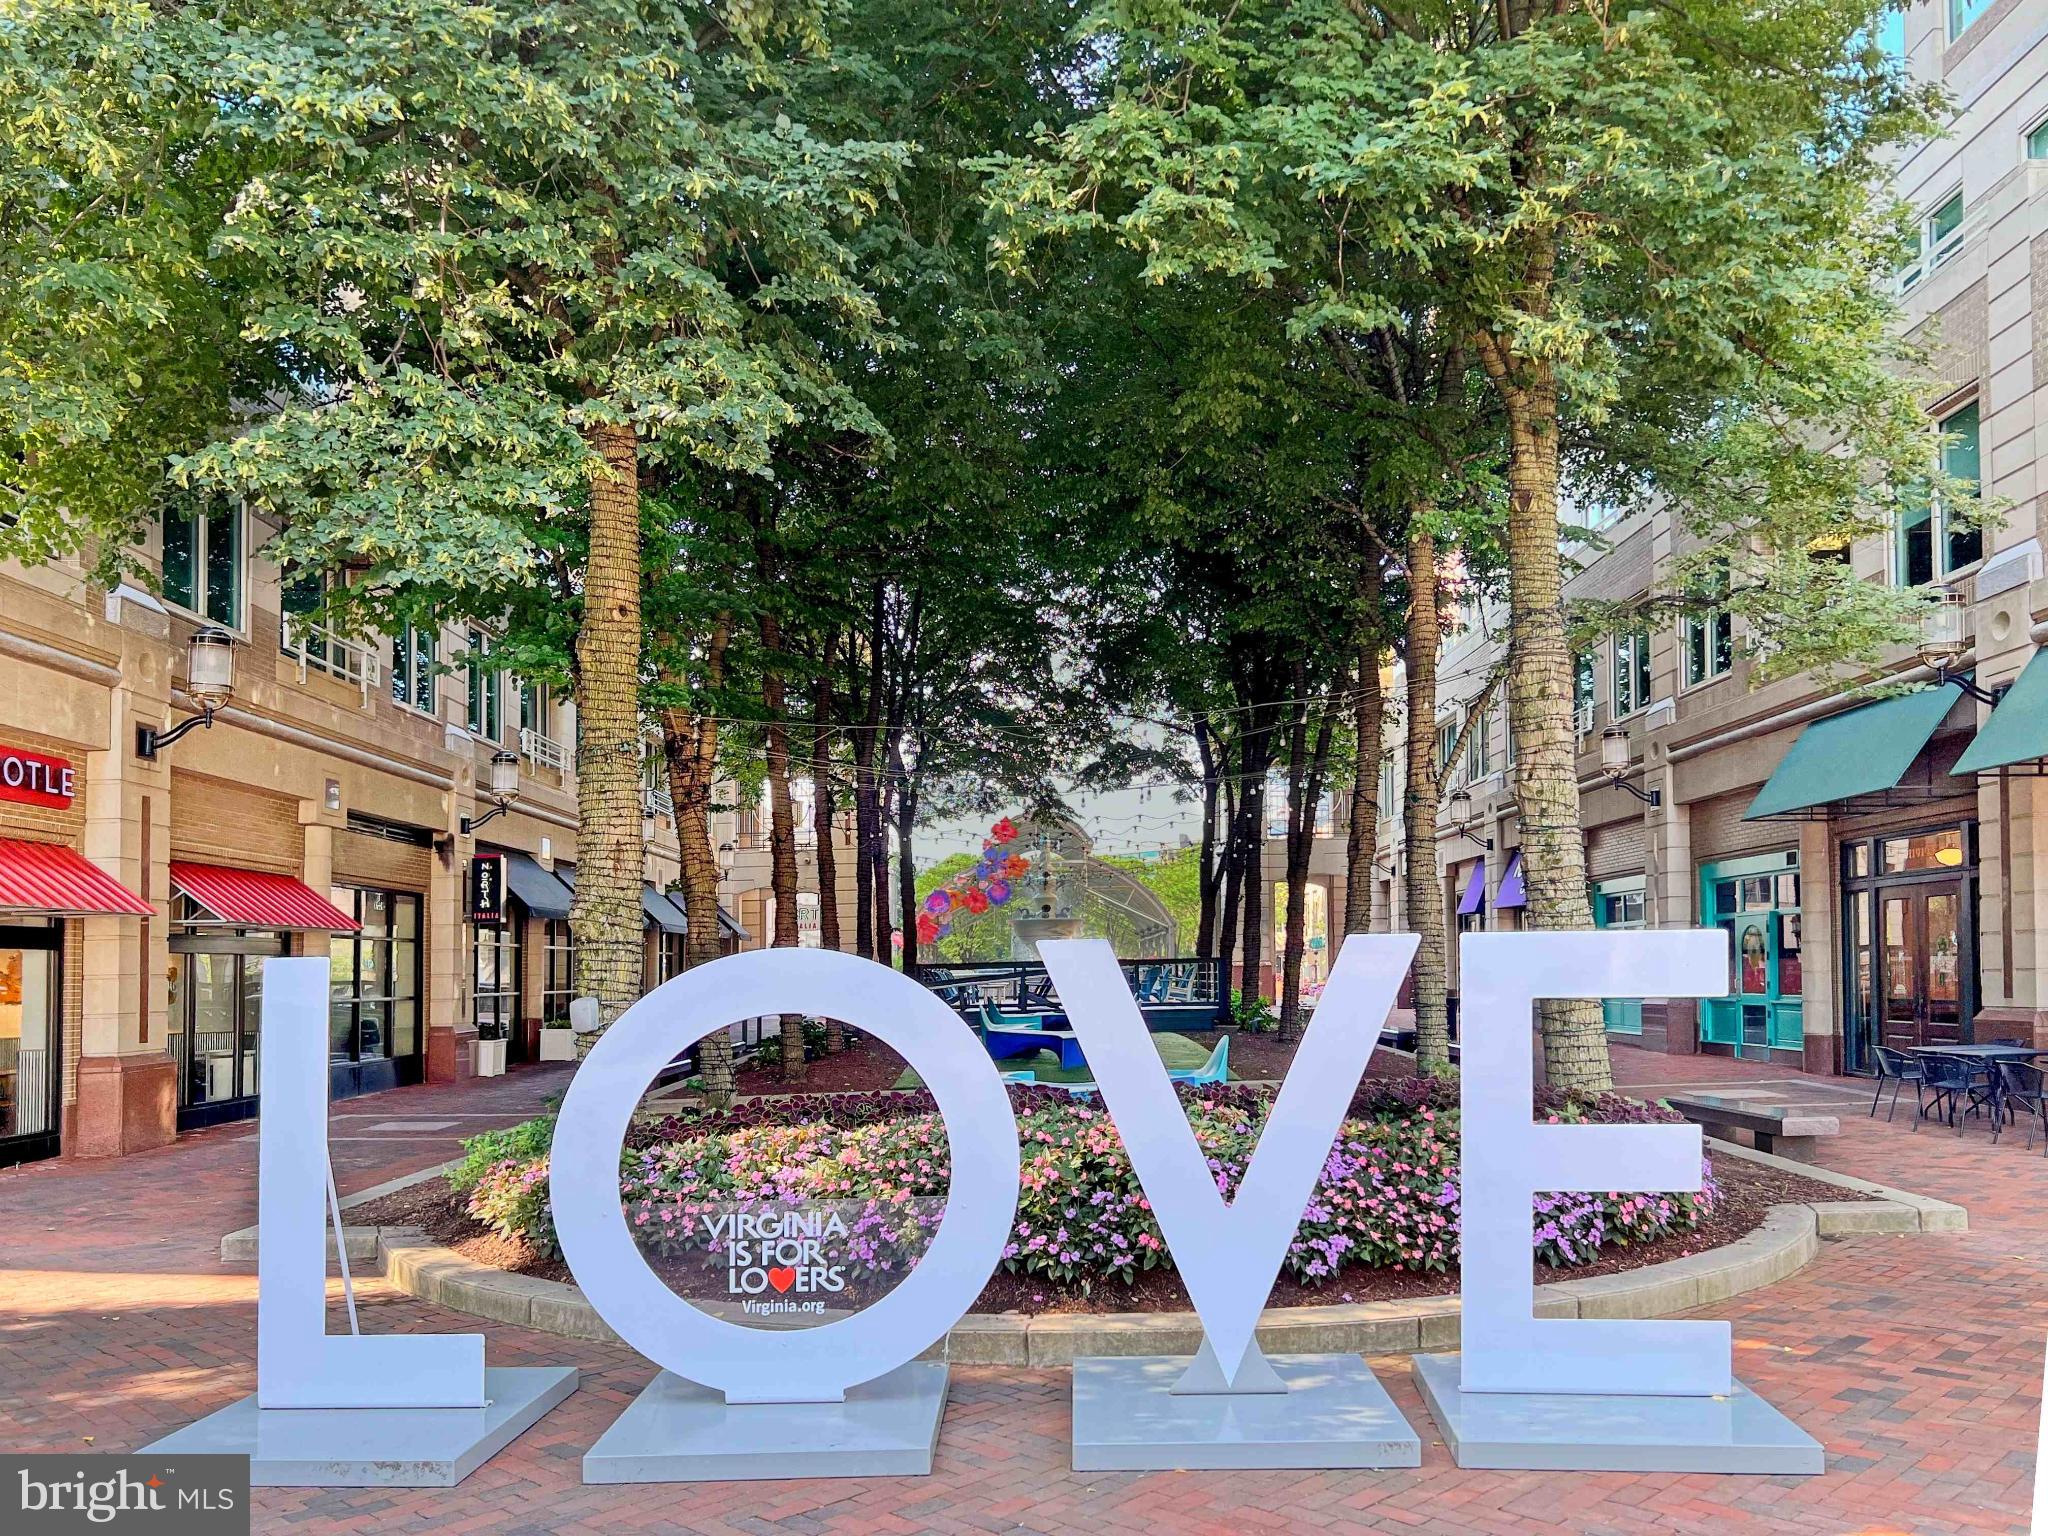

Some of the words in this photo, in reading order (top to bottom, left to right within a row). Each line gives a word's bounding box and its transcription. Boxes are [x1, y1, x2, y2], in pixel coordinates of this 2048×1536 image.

[3, 756, 76, 797] OTLE
[257, 928, 1734, 1411] LOVE
[701, 1211, 849, 1239] VIRGINIA
[729, 1240, 753, 1267] IS
[761, 1239, 828, 1267] FOR
[741, 1299, 826, 1316] Virginia.org
